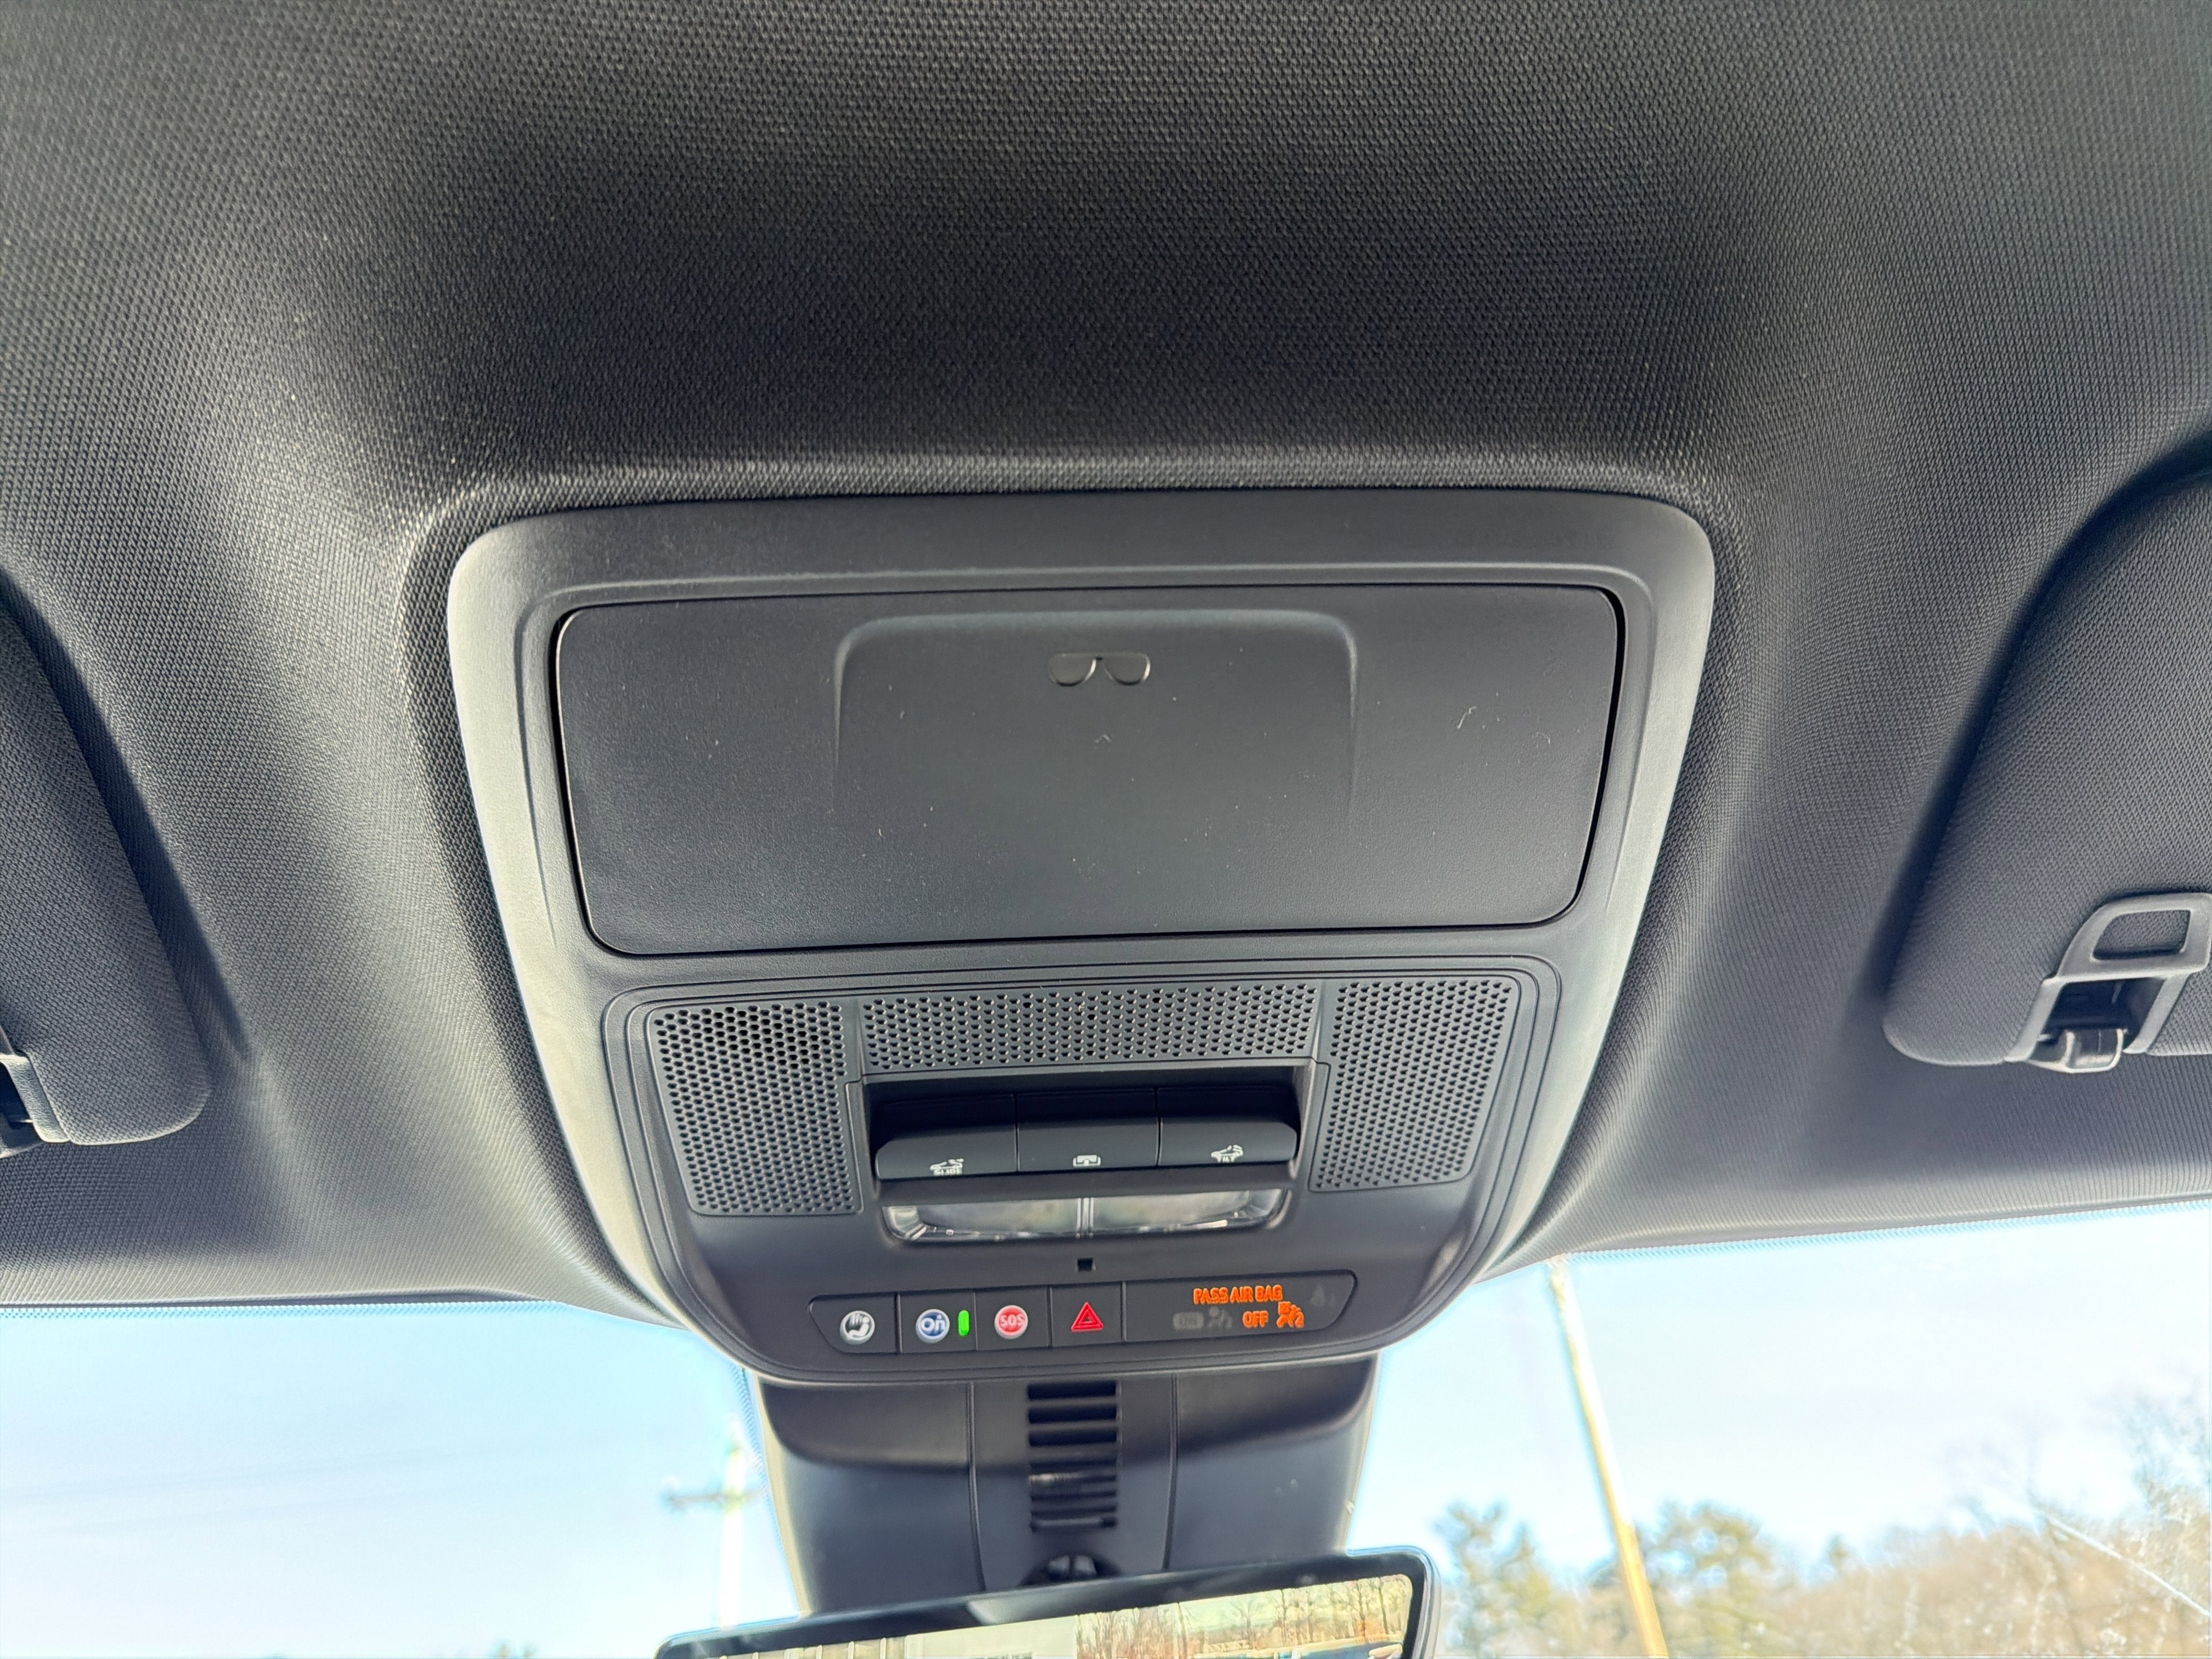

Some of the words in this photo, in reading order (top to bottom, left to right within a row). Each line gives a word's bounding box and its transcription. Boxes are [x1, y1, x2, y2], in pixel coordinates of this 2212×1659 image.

[1193, 1287, 1228, 1304] PASS
[1230, 1285, 1253, 1303] AIR
[1255, 1284, 1283, 1302] BAG
[1000, 1313, 1025, 1328] SOS
[1243, 1310, 1269, 1328] OFF
